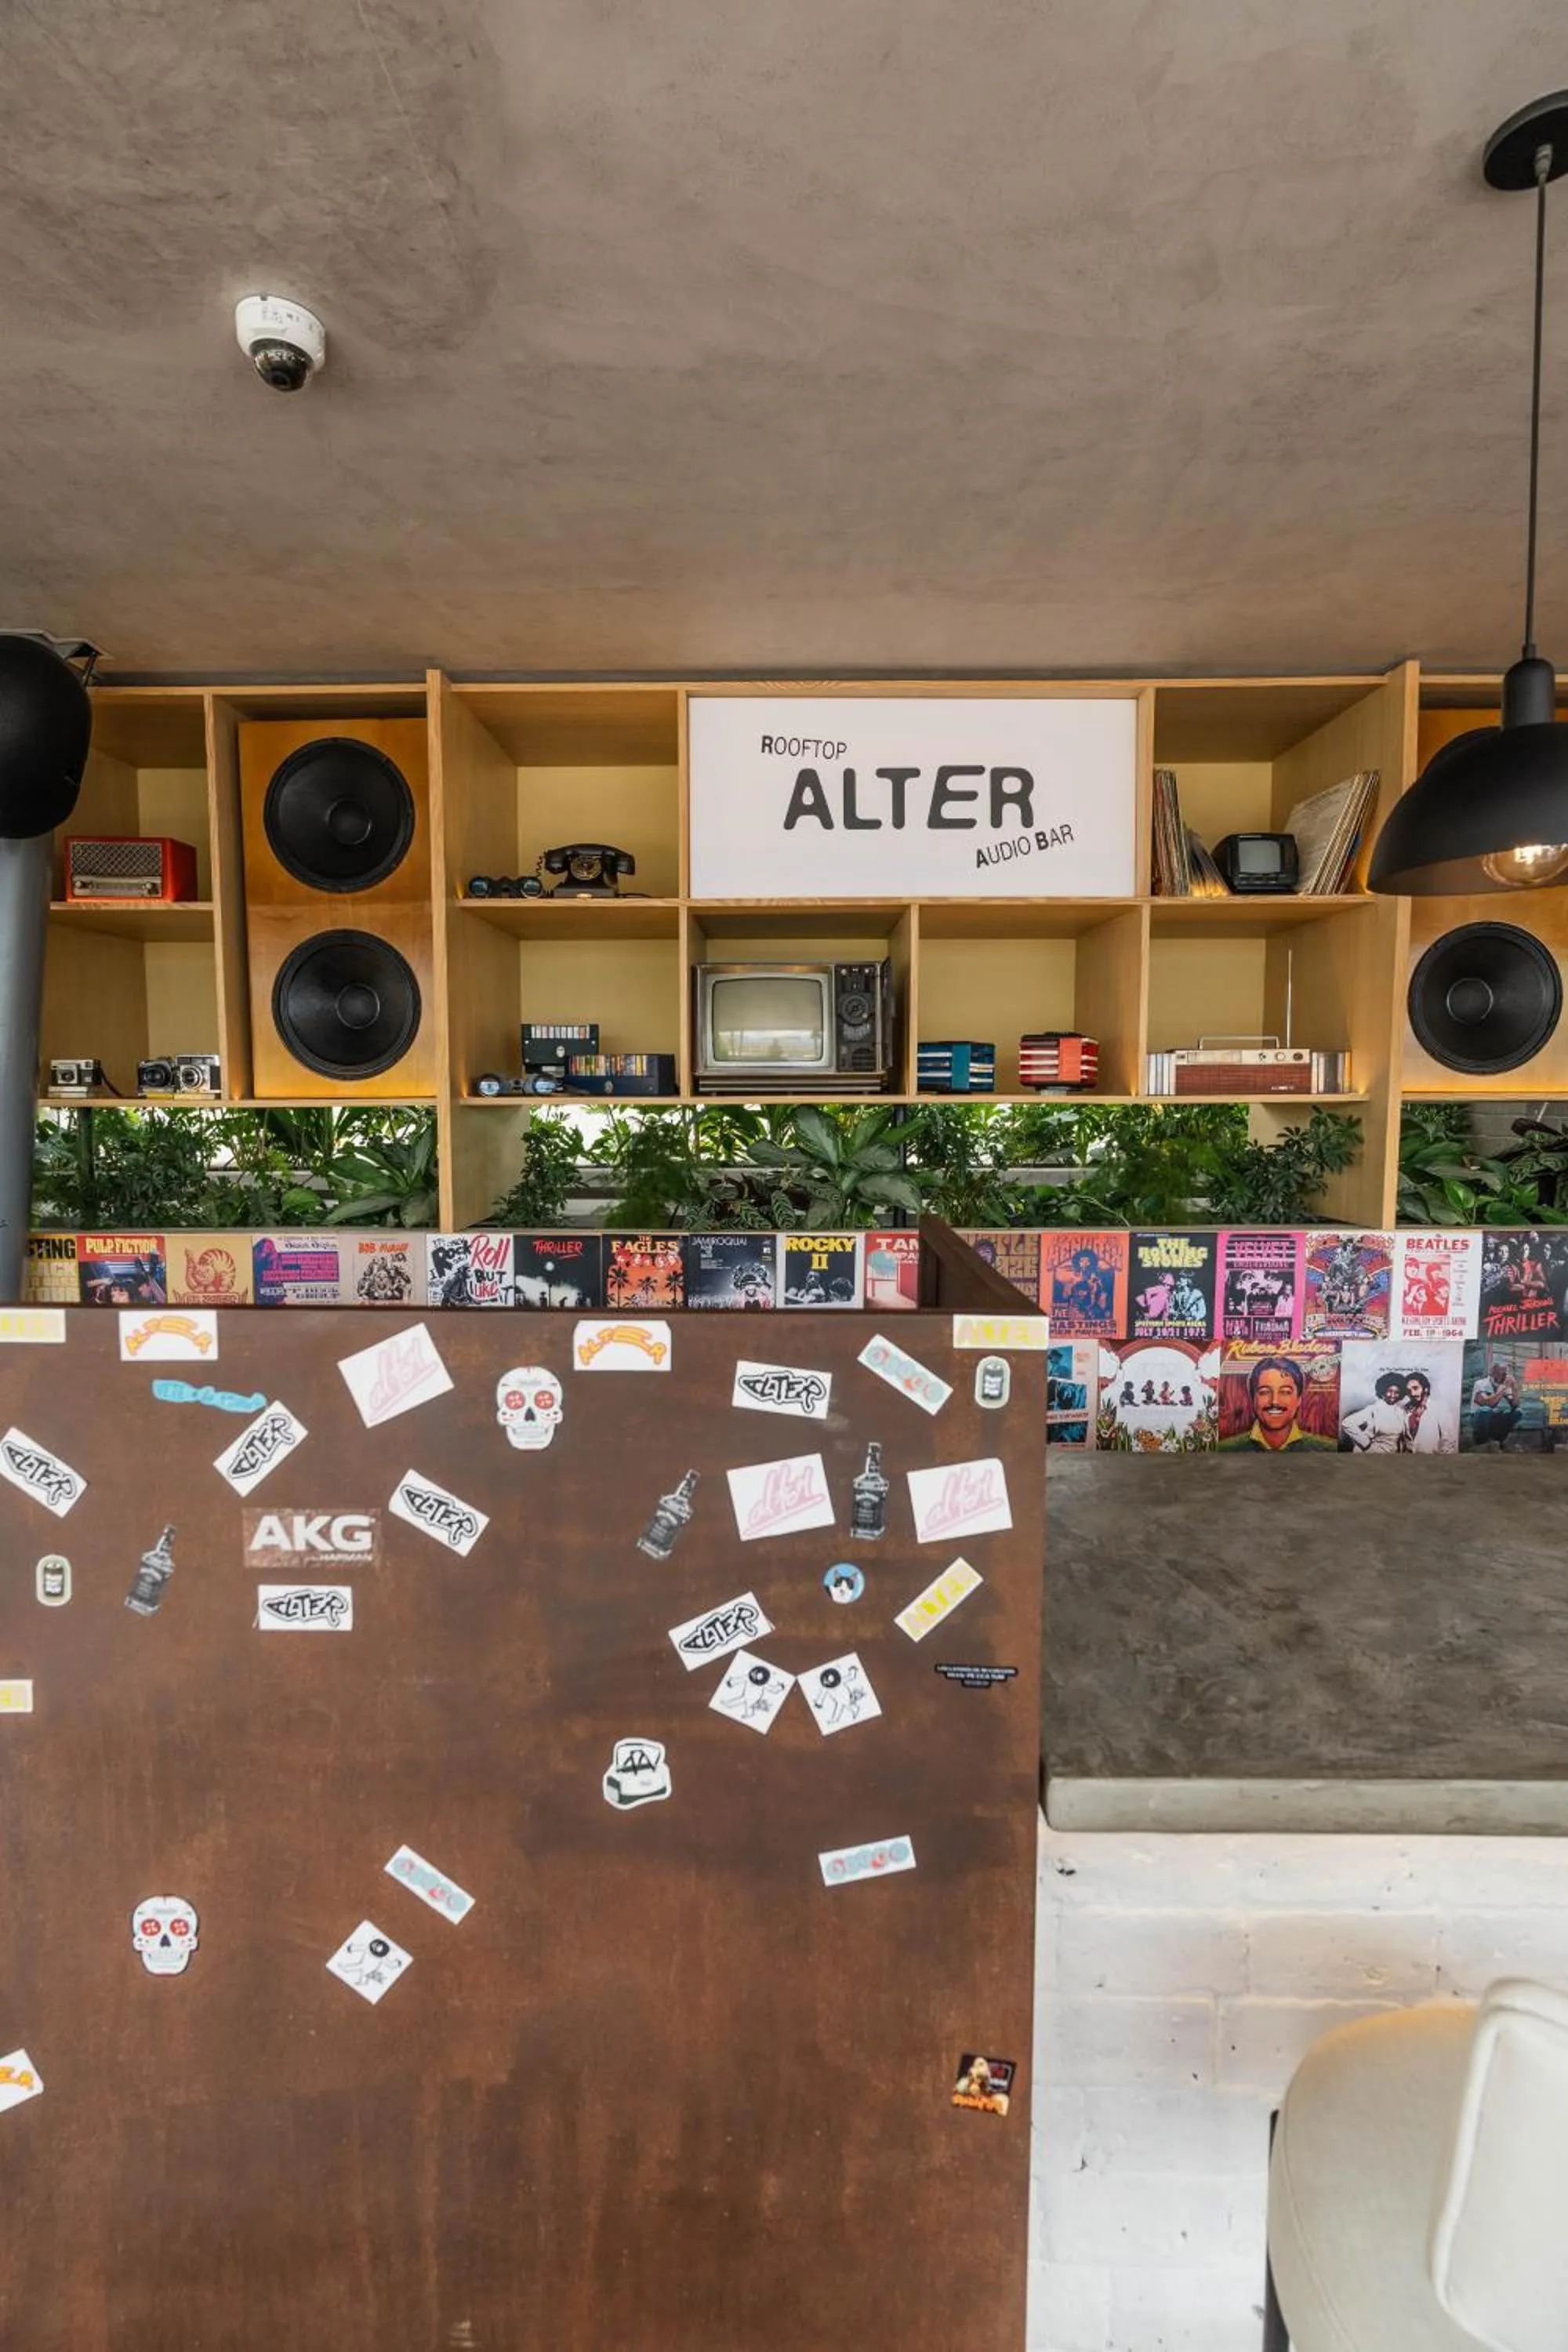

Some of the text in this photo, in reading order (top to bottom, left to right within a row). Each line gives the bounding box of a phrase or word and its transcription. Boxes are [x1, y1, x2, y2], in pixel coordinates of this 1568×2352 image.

[760, 735, 848, 760] ROOFTOP
[783, 764, 1034, 830] ALTER
[976, 824, 1074, 868] AUDIO BAR
[85, 1236, 156, 1254] PULP FICTION
[533, 1240, 583, 1254] THRILLER
[611, 1241, 678, 1254] EAGLES
[785, 1236, 855, 1252] ROCKY
[1156, 1238, 1190, 1248] THE
[1406, 1238, 1470, 1250] BEATLES
[811, 1253, 829, 1269] II
[474, 1269, 506, 1284] BUT
[1482, 1312, 1560, 1338] THRILLER
[739, 1370, 826, 1413] ALTER
[227, 1414, 295, 1479] ALTER
[2, 1441, 76, 1504] ALTER
[401, 1484, 478, 1545] ALTER
[249, 1515, 372, 1552] AKG
[263, 1591, 348, 1627] ALTER
[679, 1603, 759, 1652] ALTER
